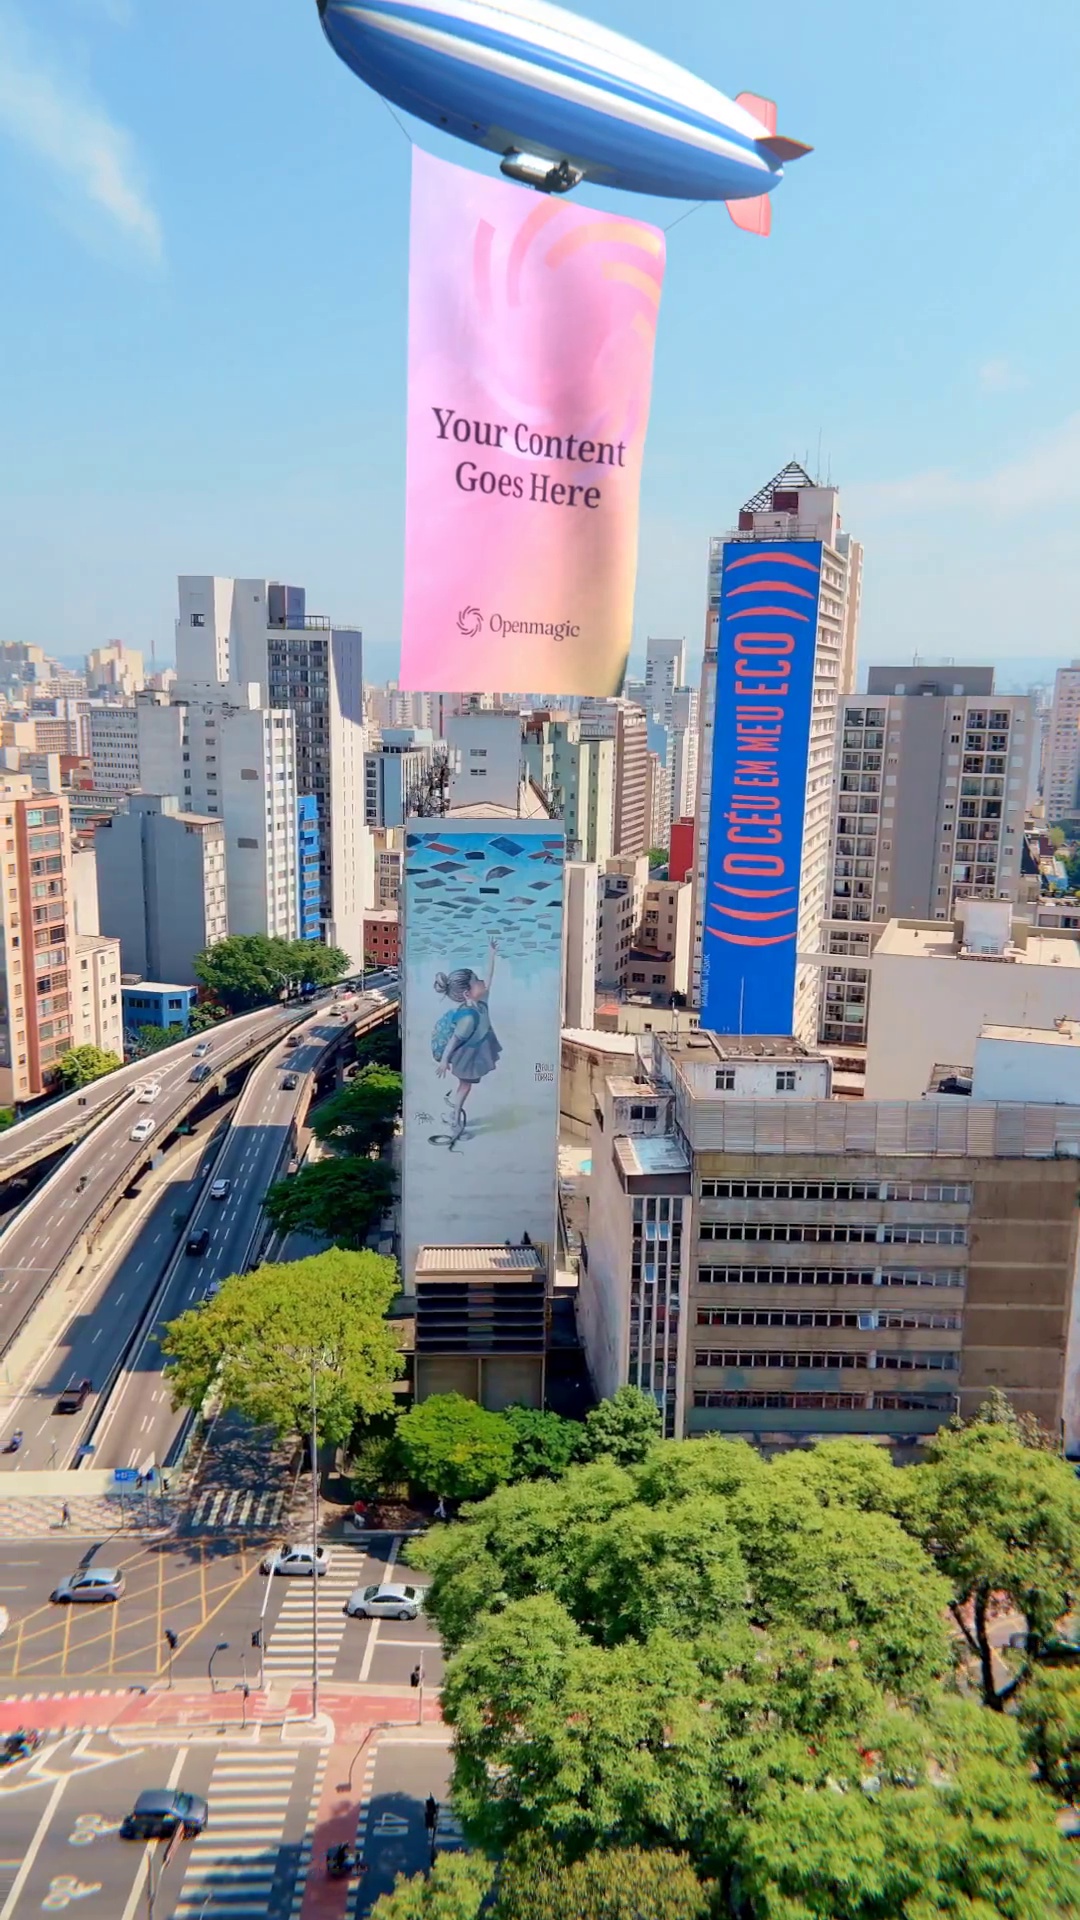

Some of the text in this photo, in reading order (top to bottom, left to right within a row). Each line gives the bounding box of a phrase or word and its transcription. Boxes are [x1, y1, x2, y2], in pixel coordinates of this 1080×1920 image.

[431, 407, 626, 467] Your Content
[455, 461, 601, 509] Goes Here
[489, 613, 580, 641] Openmagic
[723, 632, 795, 877] O CÉU EM MEU ECO
[373, 1812, 409, 1836] 40
